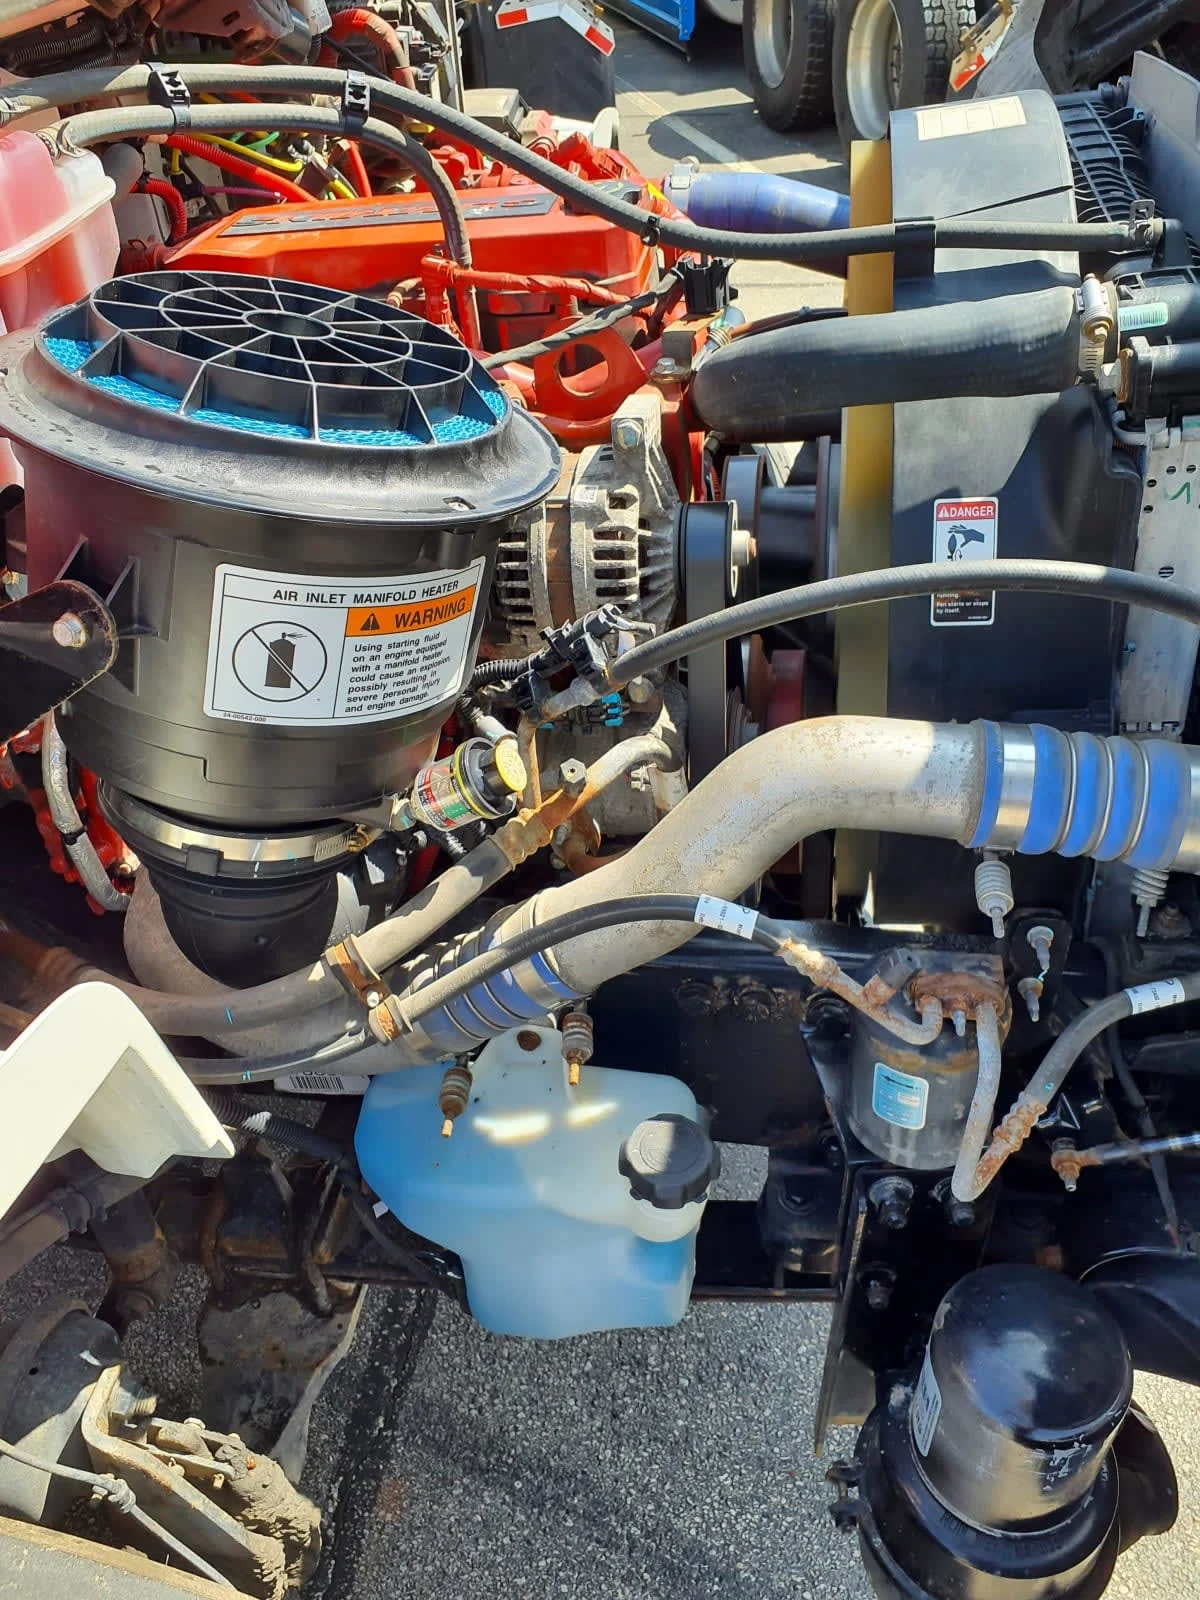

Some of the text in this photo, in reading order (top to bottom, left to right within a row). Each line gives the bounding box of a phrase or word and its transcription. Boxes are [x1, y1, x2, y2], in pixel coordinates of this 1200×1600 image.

[950, 505, 994, 518] DANGER
[273, 580, 459, 604] AIR INLET MANIFOLD HEATER
[395, 597, 467, 628] WARNING
[352, 638, 448, 663] on an engine equipped
[354, 631, 441, 653] Using starting fluid
[349, 655, 451, 683] could cause an explosion
[351, 664, 371, 673] with
[384, 656, 419, 670] manifold
[422, 649, 444, 662] heater
[346, 677, 441, 703] severe personal injury
[347, 682, 388, 695] possibly
[392, 673, 427, 688] resulting
[344, 692, 430, 713] and engine damage.
